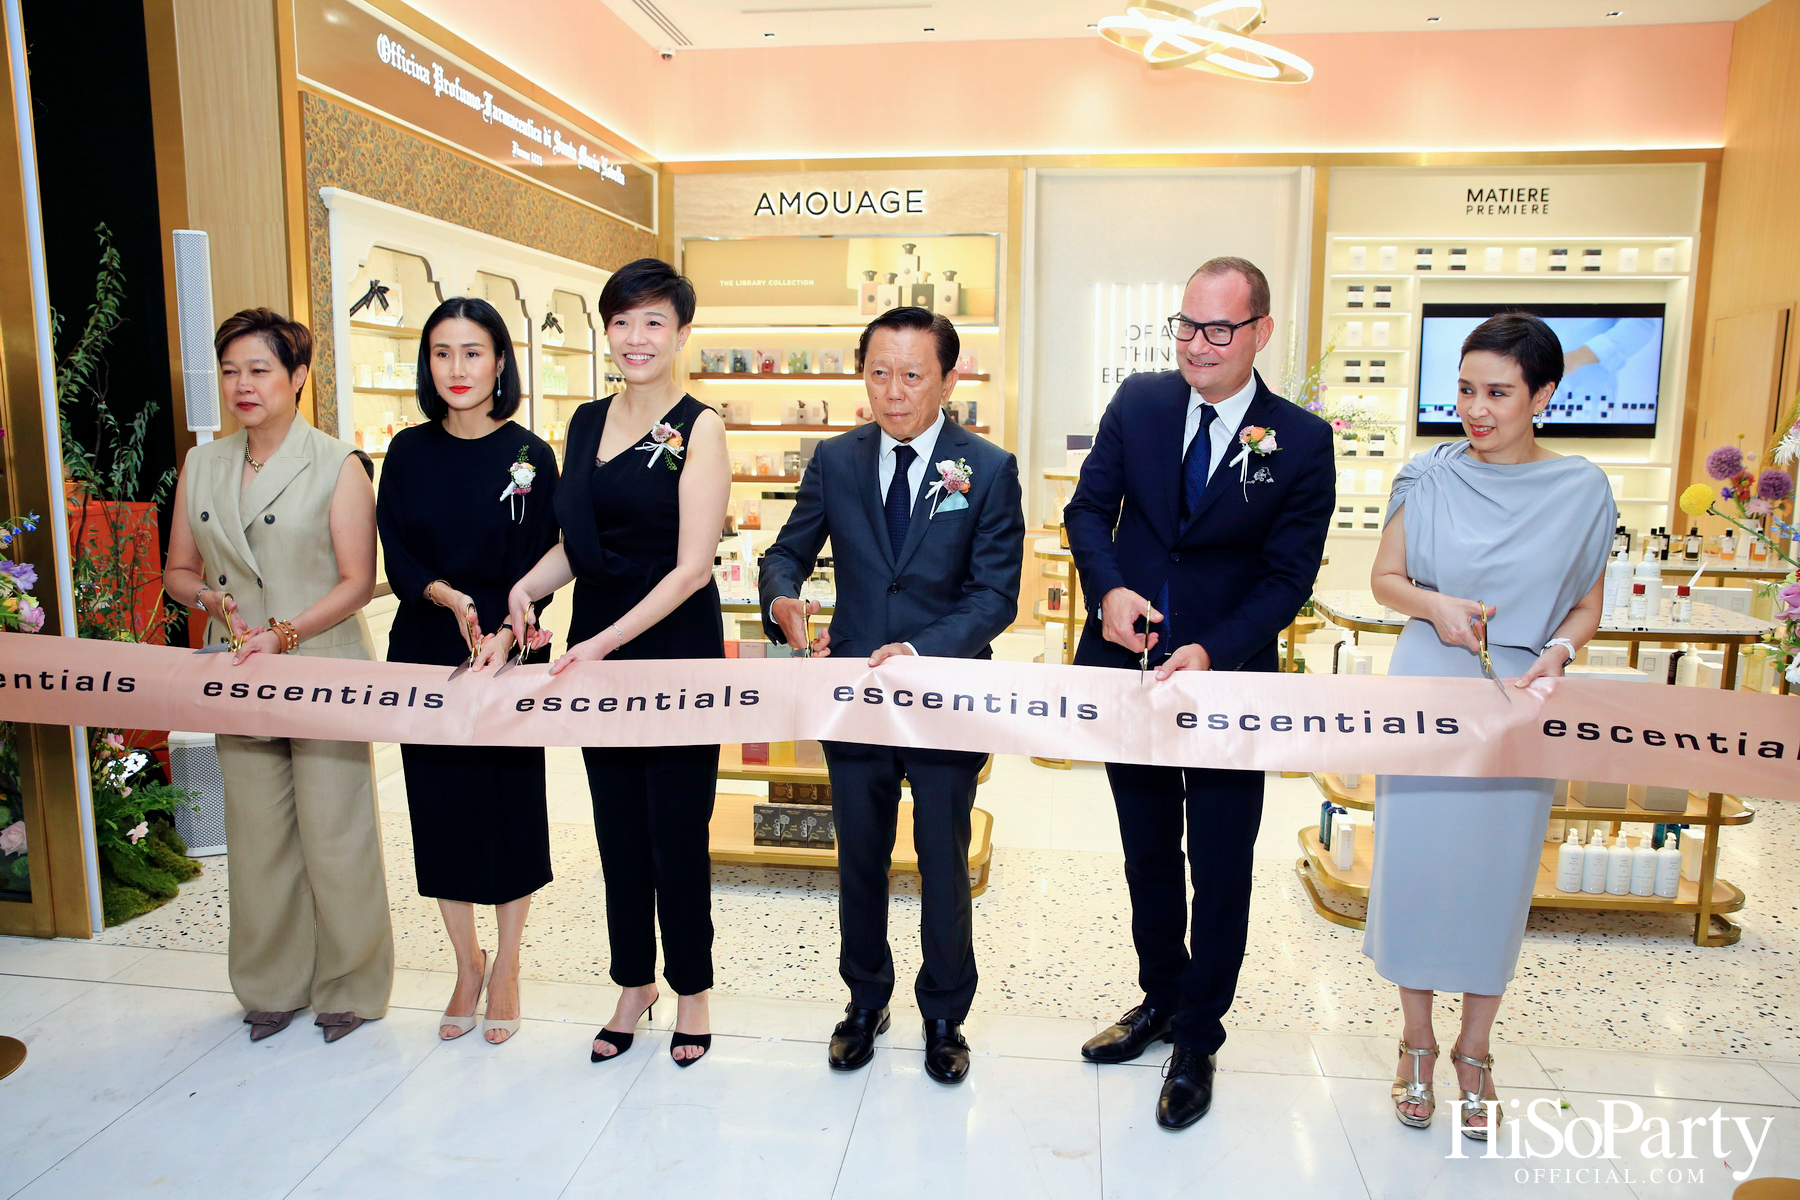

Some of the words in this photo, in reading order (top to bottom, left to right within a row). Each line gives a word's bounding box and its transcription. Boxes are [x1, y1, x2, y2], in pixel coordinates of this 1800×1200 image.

[376, 33, 431, 85] Officina
[753, 189, 924, 217] AMOUAGE
[1466, 187, 1550, 203] MATIERE
[1465, 203, 1549, 216] PREMIERE
[719, 279, 734, 287] THE
[735, 279, 767, 287] LIBRARY
[1125, 324, 1153, 341] OF
[203, 681, 445, 709] escentials
[515, 685, 760, 713] escentials
[832, 682, 1099, 721] escentials
[1175, 710, 1460, 736] escentials
